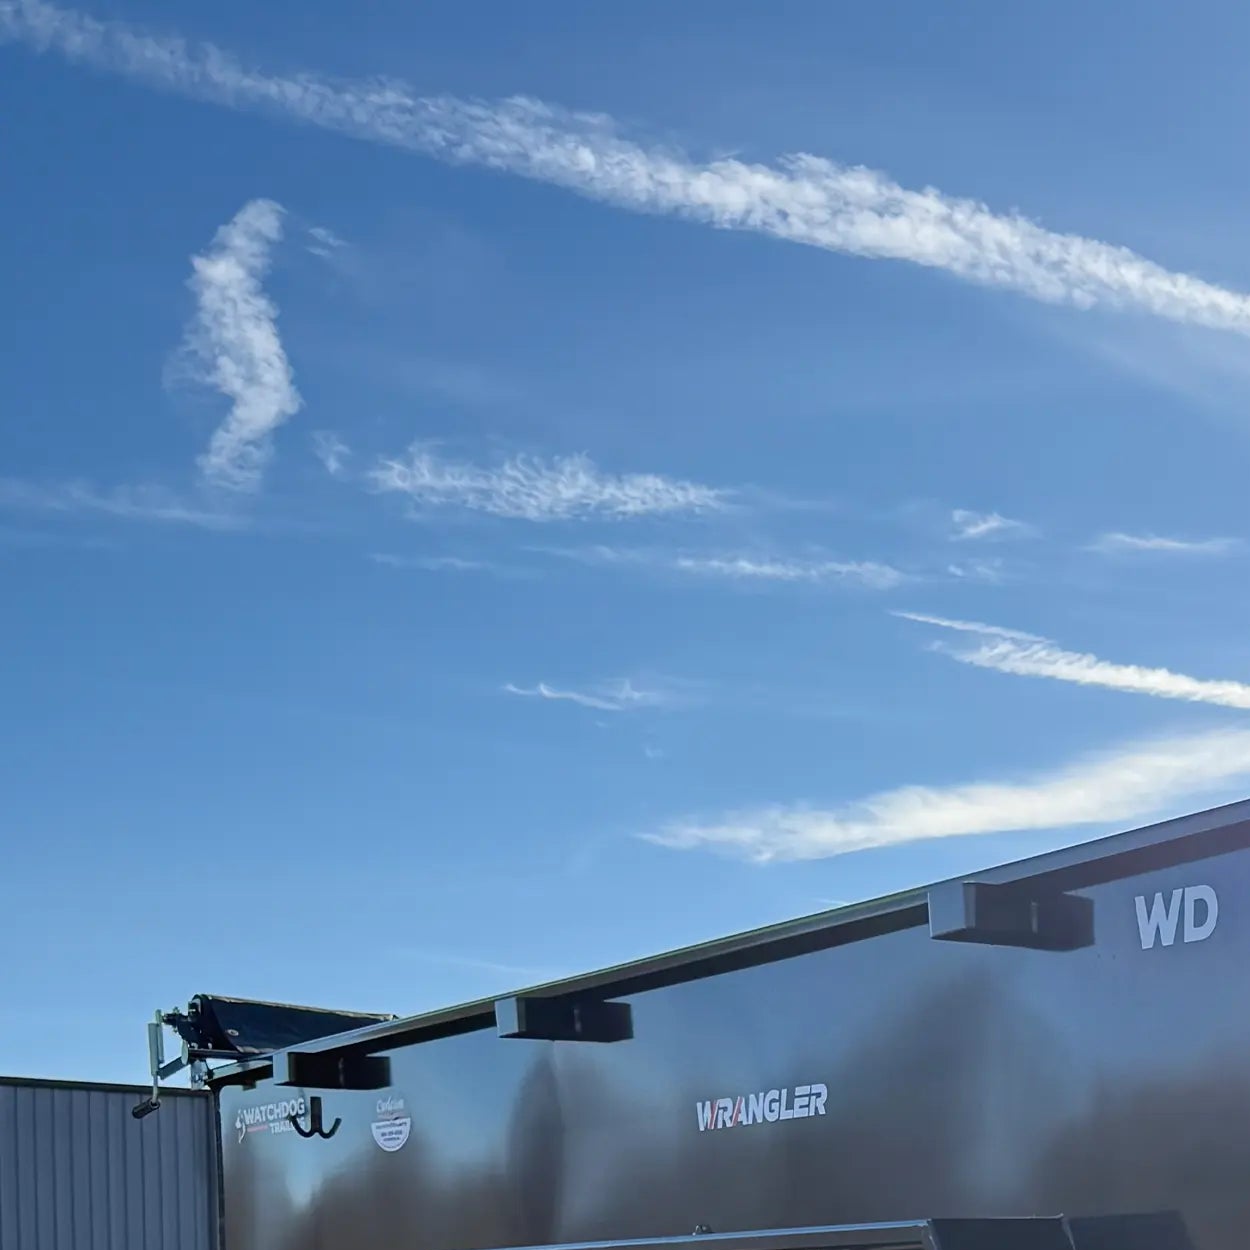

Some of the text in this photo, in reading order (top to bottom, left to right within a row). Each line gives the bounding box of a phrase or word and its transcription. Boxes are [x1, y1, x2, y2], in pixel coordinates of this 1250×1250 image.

[1134, 884, 1219, 949] WD
[243, 1097, 305, 1125] WATCHDOG
[696, 1083, 828, 1131] WRANGLER
